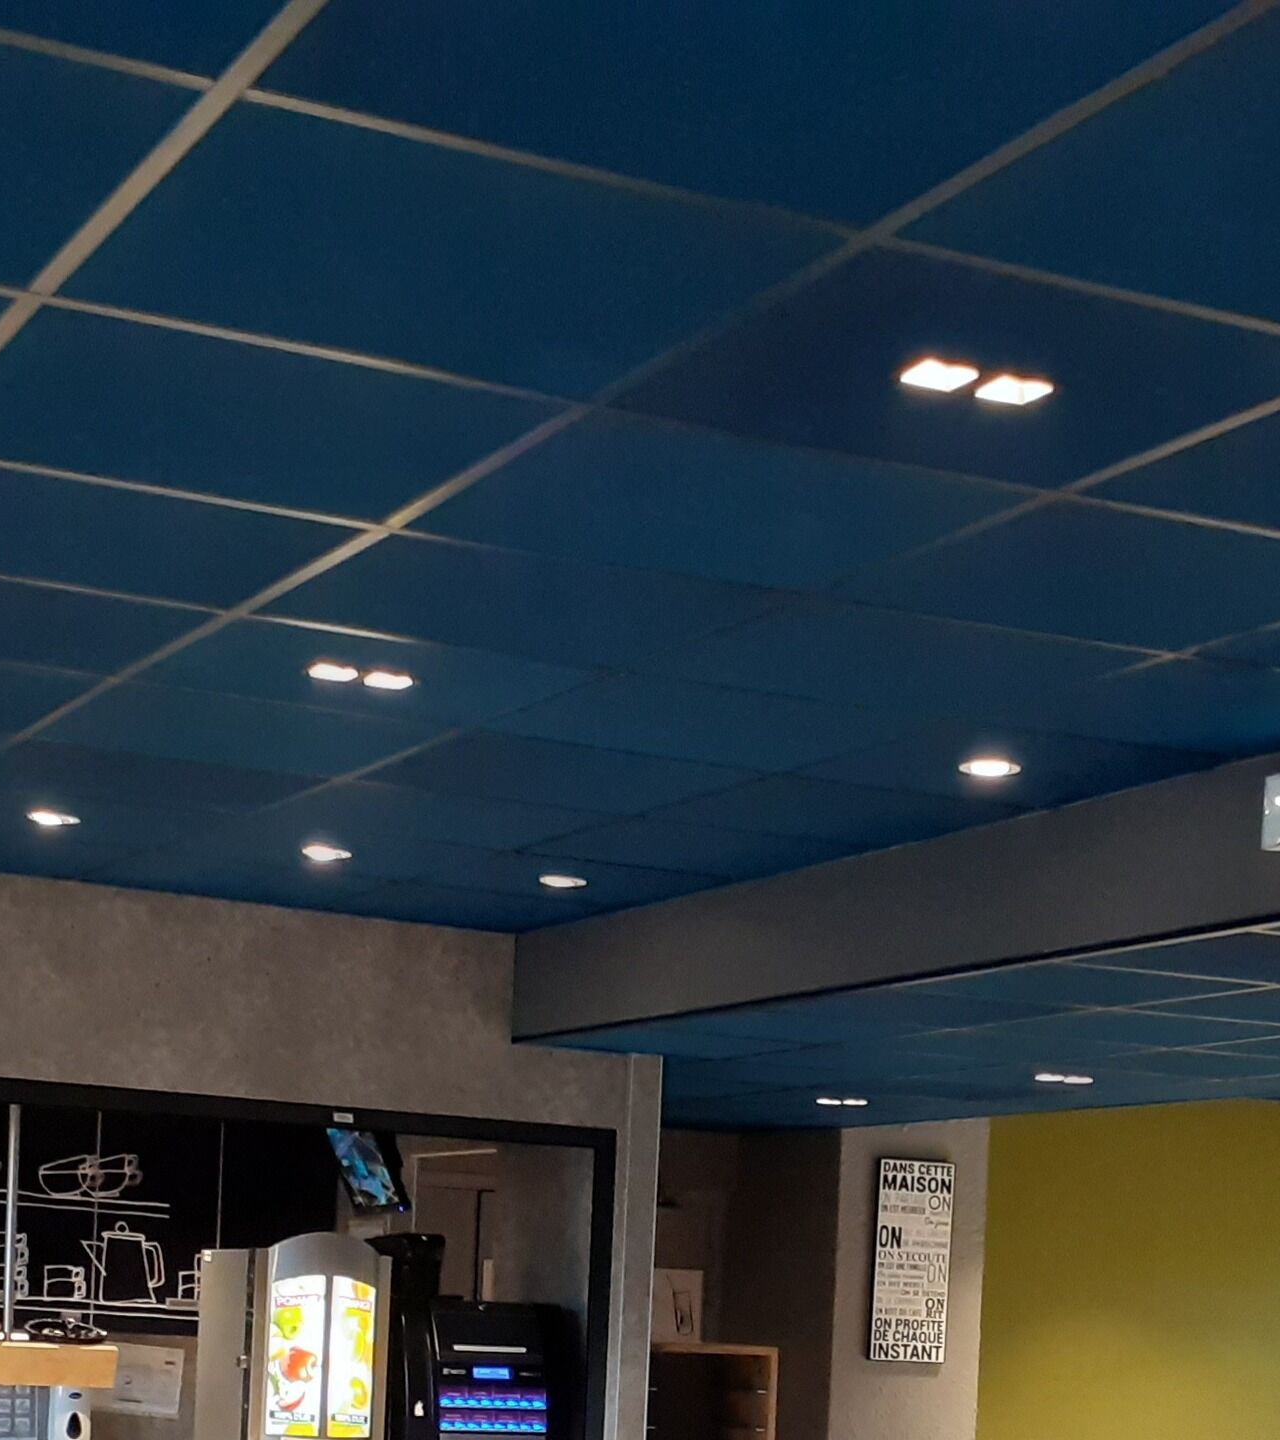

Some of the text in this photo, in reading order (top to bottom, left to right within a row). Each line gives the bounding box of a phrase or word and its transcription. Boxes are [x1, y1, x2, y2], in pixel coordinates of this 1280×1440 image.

[883, 1161, 953, 1178] DANS CETTE
[882, 1173, 952, 1195] MAISON
[928, 1195, 951, 1212] ON
[878, 1224, 902, 1249] ON
[878, 1250, 894, 1261] ON
[927, 1263, 947, 1284] ON
[925, 1297, 945, 1310] ON
[925, 1309, 944, 1319] RIT
[874, 1317, 944, 1332] ON PROFITE
[873, 1329, 944, 1345] DE CHAQUE
[872, 1342, 943, 1361] INSTANT
